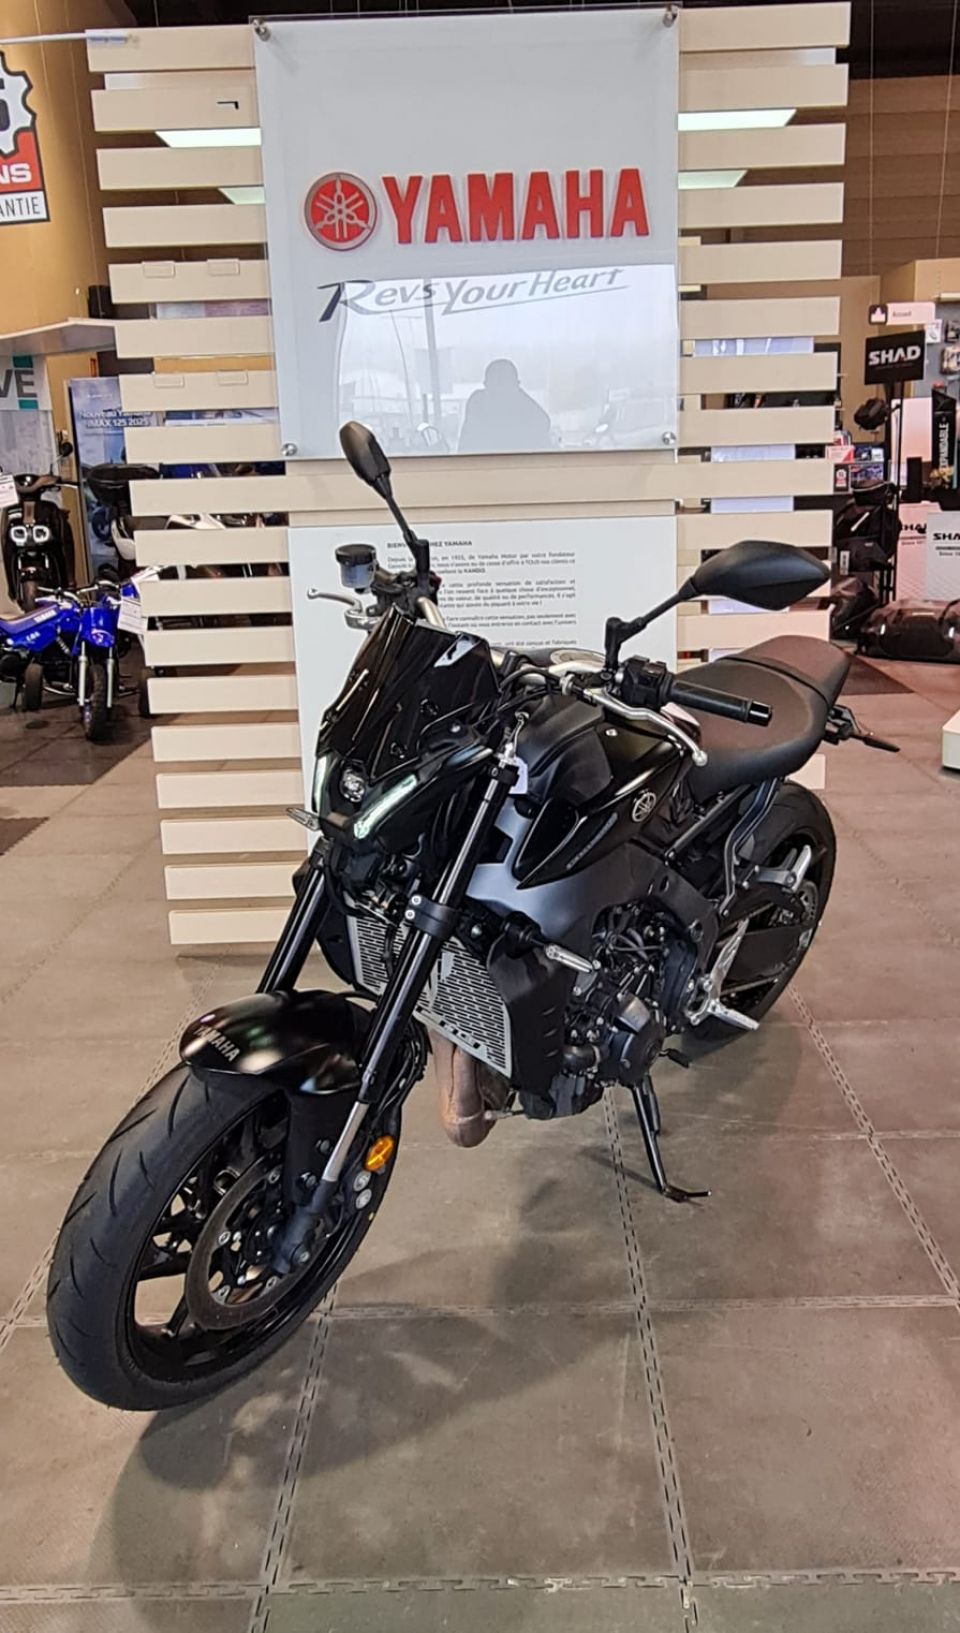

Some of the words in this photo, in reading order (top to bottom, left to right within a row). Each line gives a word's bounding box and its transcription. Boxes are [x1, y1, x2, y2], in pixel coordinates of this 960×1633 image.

[382, 168, 650, 245] YAMAHA
[317, 279, 440, 323] Revs
[442, 279, 528, 316] Your
[528, 268, 626, 297] Heart
[868, 345, 922, 367] SHAD
